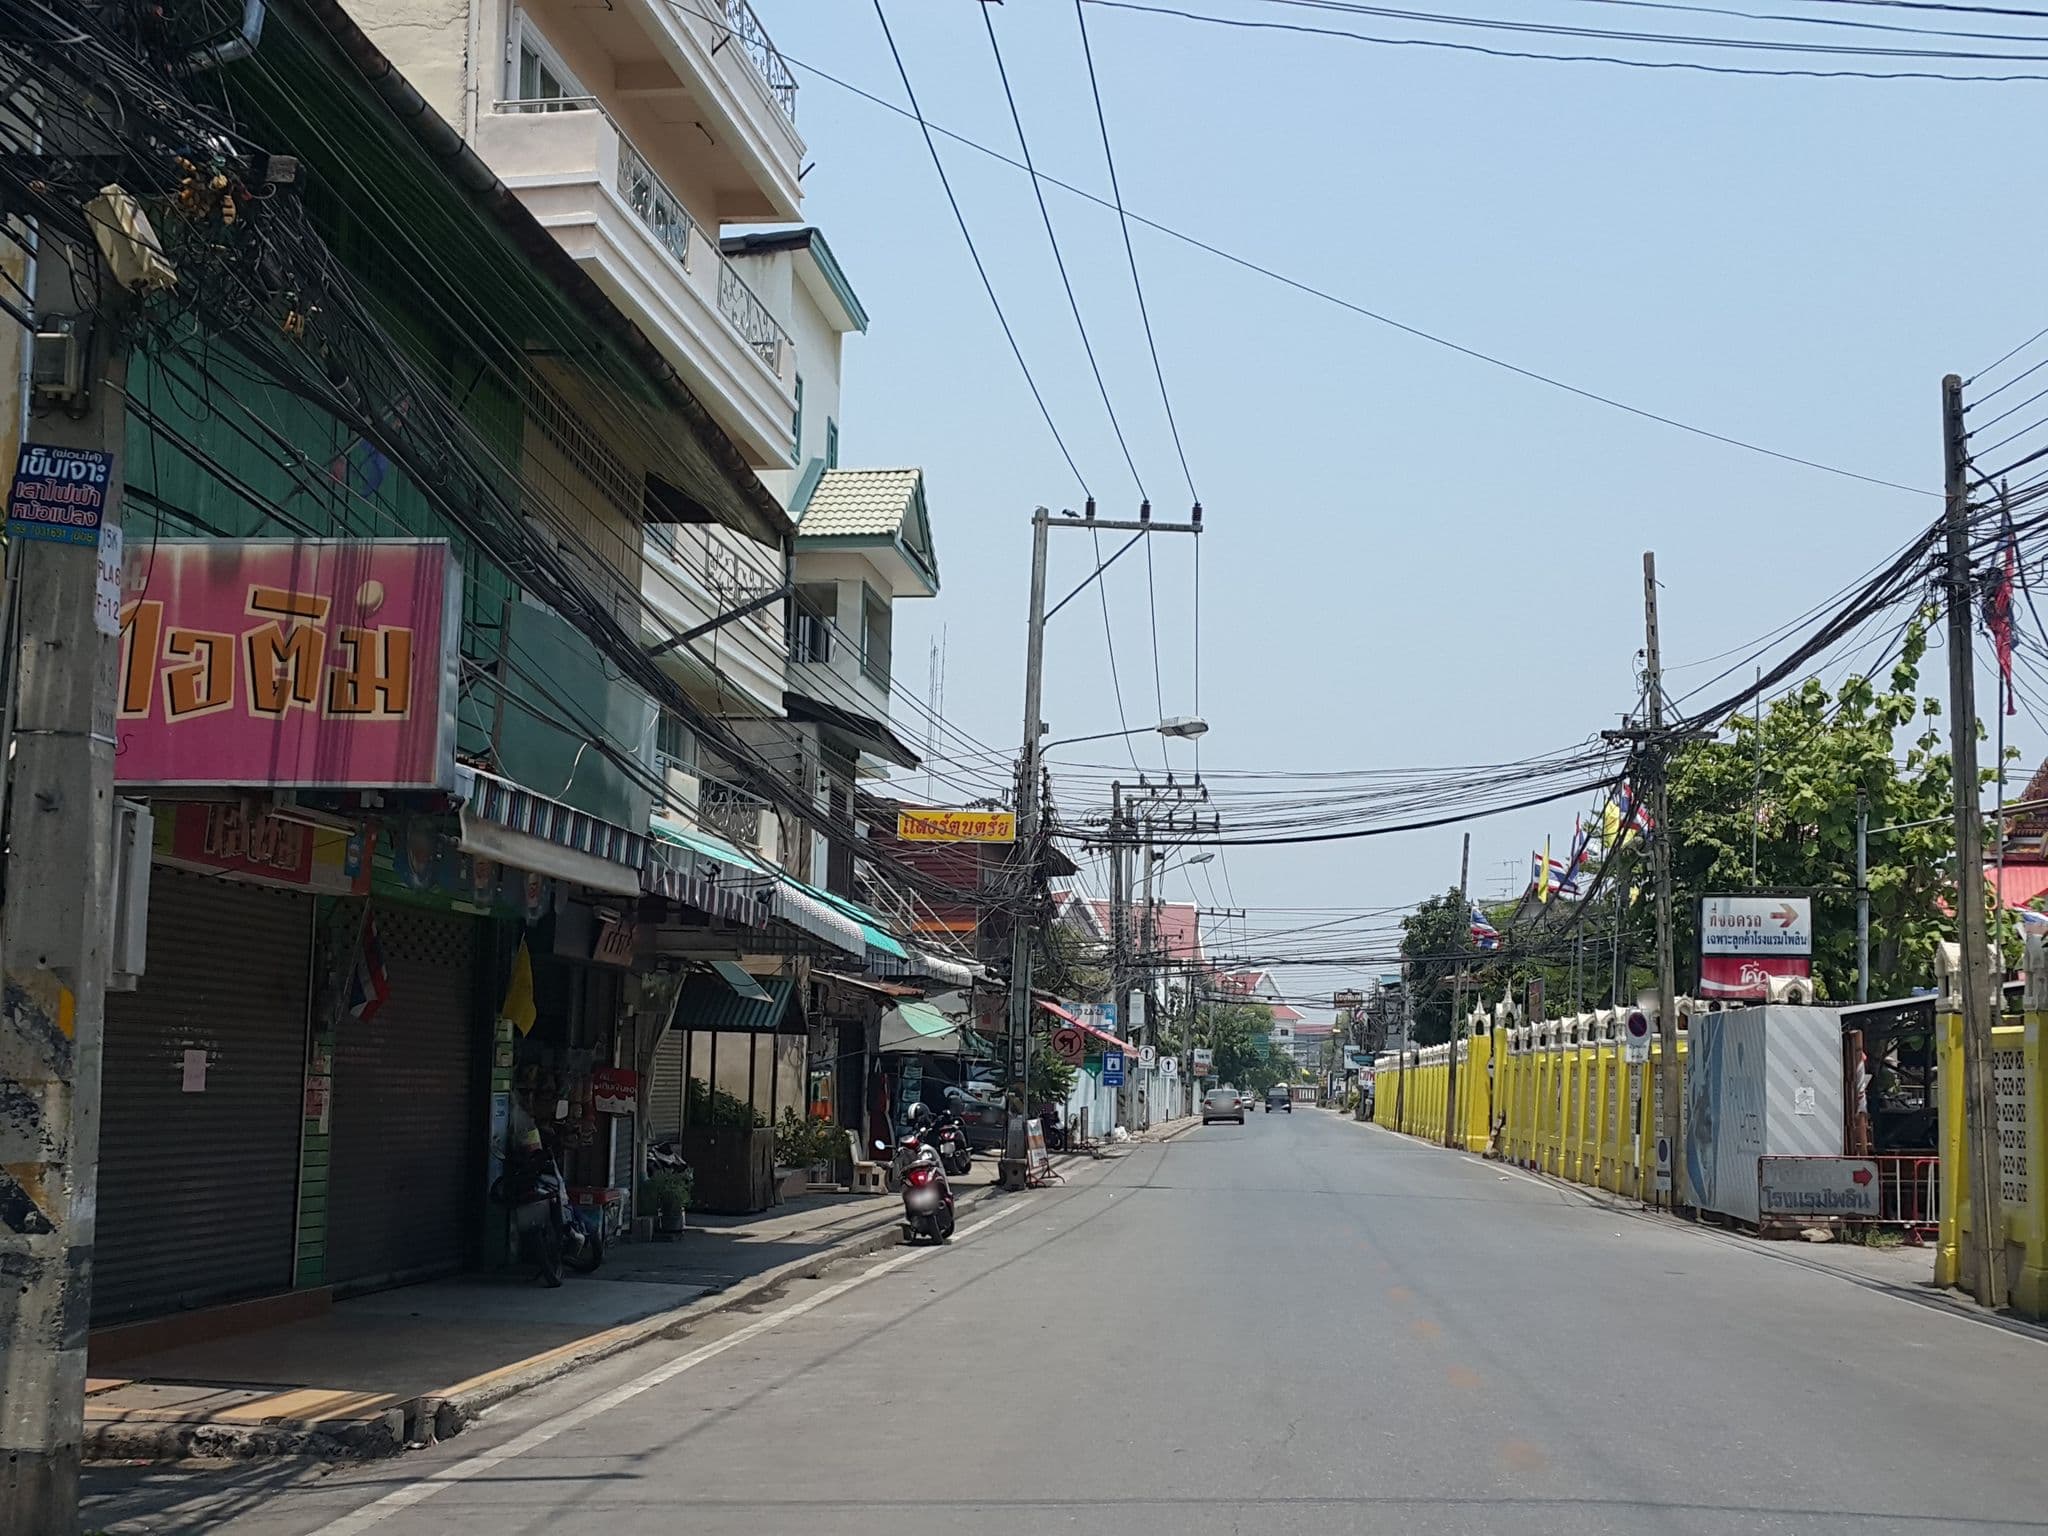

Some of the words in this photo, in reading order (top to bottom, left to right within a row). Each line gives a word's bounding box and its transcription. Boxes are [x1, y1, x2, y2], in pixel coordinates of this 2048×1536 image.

[21, 448, 107, 483] เข็มเจาะ
[16, 478, 101, 507] เสาไฟฟ้า
[11, 500, 98, 527] หม้อแปลง
[903, 813, 1009, 837] แสงรัตนตรัย
[1706, 930, 1808, 950] เฉพาะลูกค้าโรงแรมไพลิน
[1762, 1185, 1872, 1209] โรงแรมไพลิน
